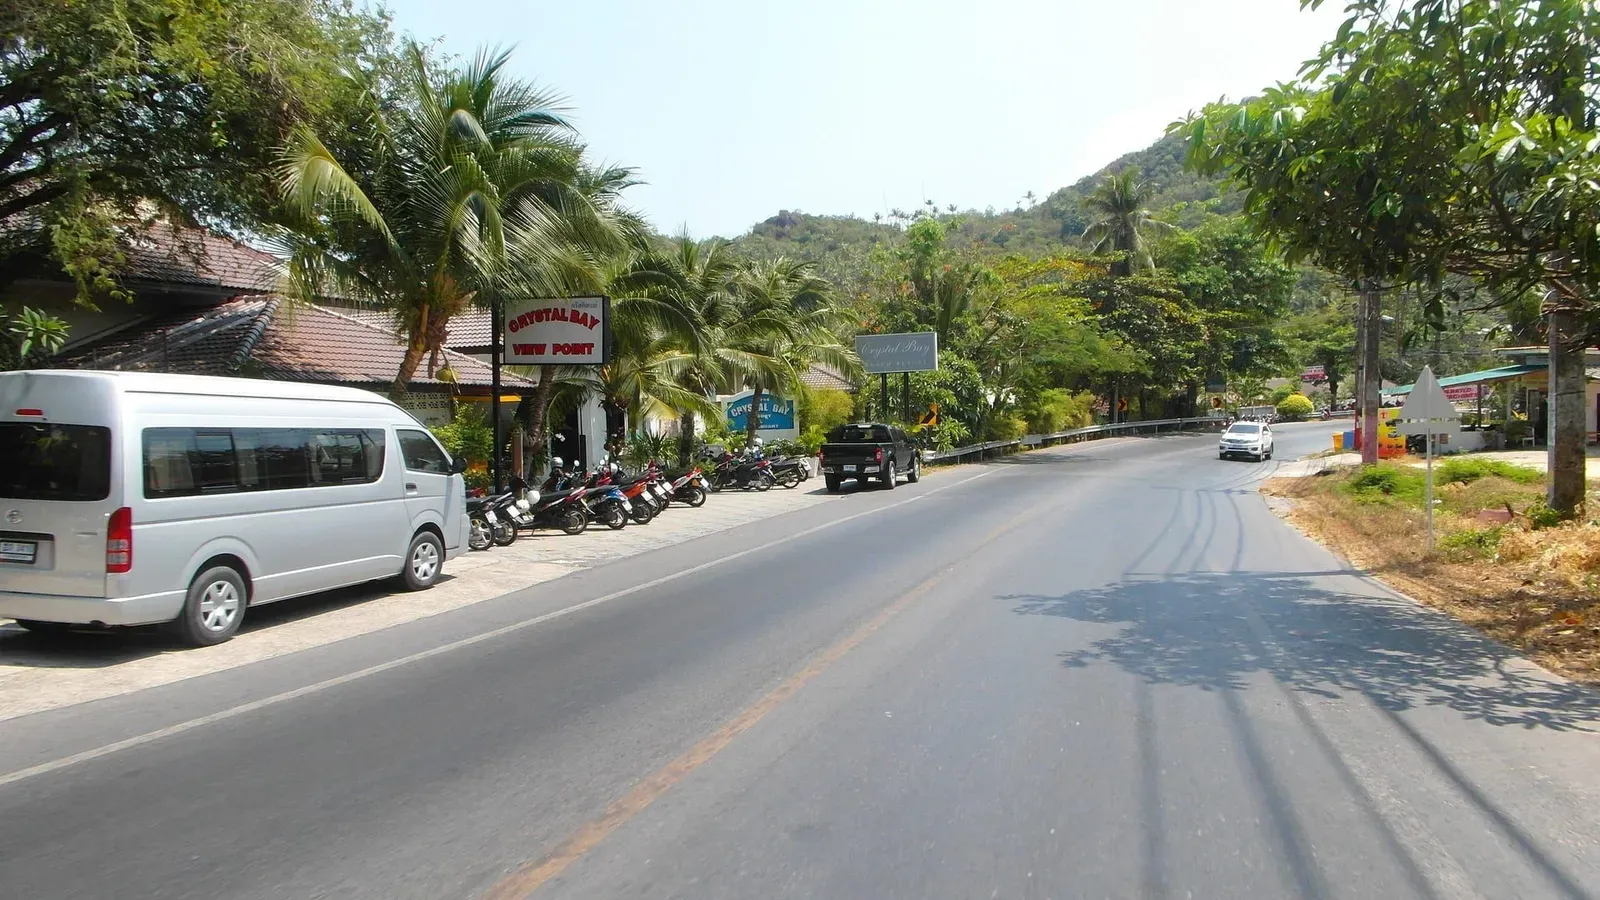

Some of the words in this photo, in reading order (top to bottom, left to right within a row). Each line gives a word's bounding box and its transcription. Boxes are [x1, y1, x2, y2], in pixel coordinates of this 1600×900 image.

[508, 307, 569, 333] CRYSTAL
[569, 309, 600, 330] BAY
[512, 343, 547, 355] VIEW
[552, 342, 595, 355] POINT
[861, 341, 900, 358] Crystal
[902, 339, 930, 356] Bay
[730, 402, 769, 417] CRYSAL
[772, 403, 790, 415] BAY
